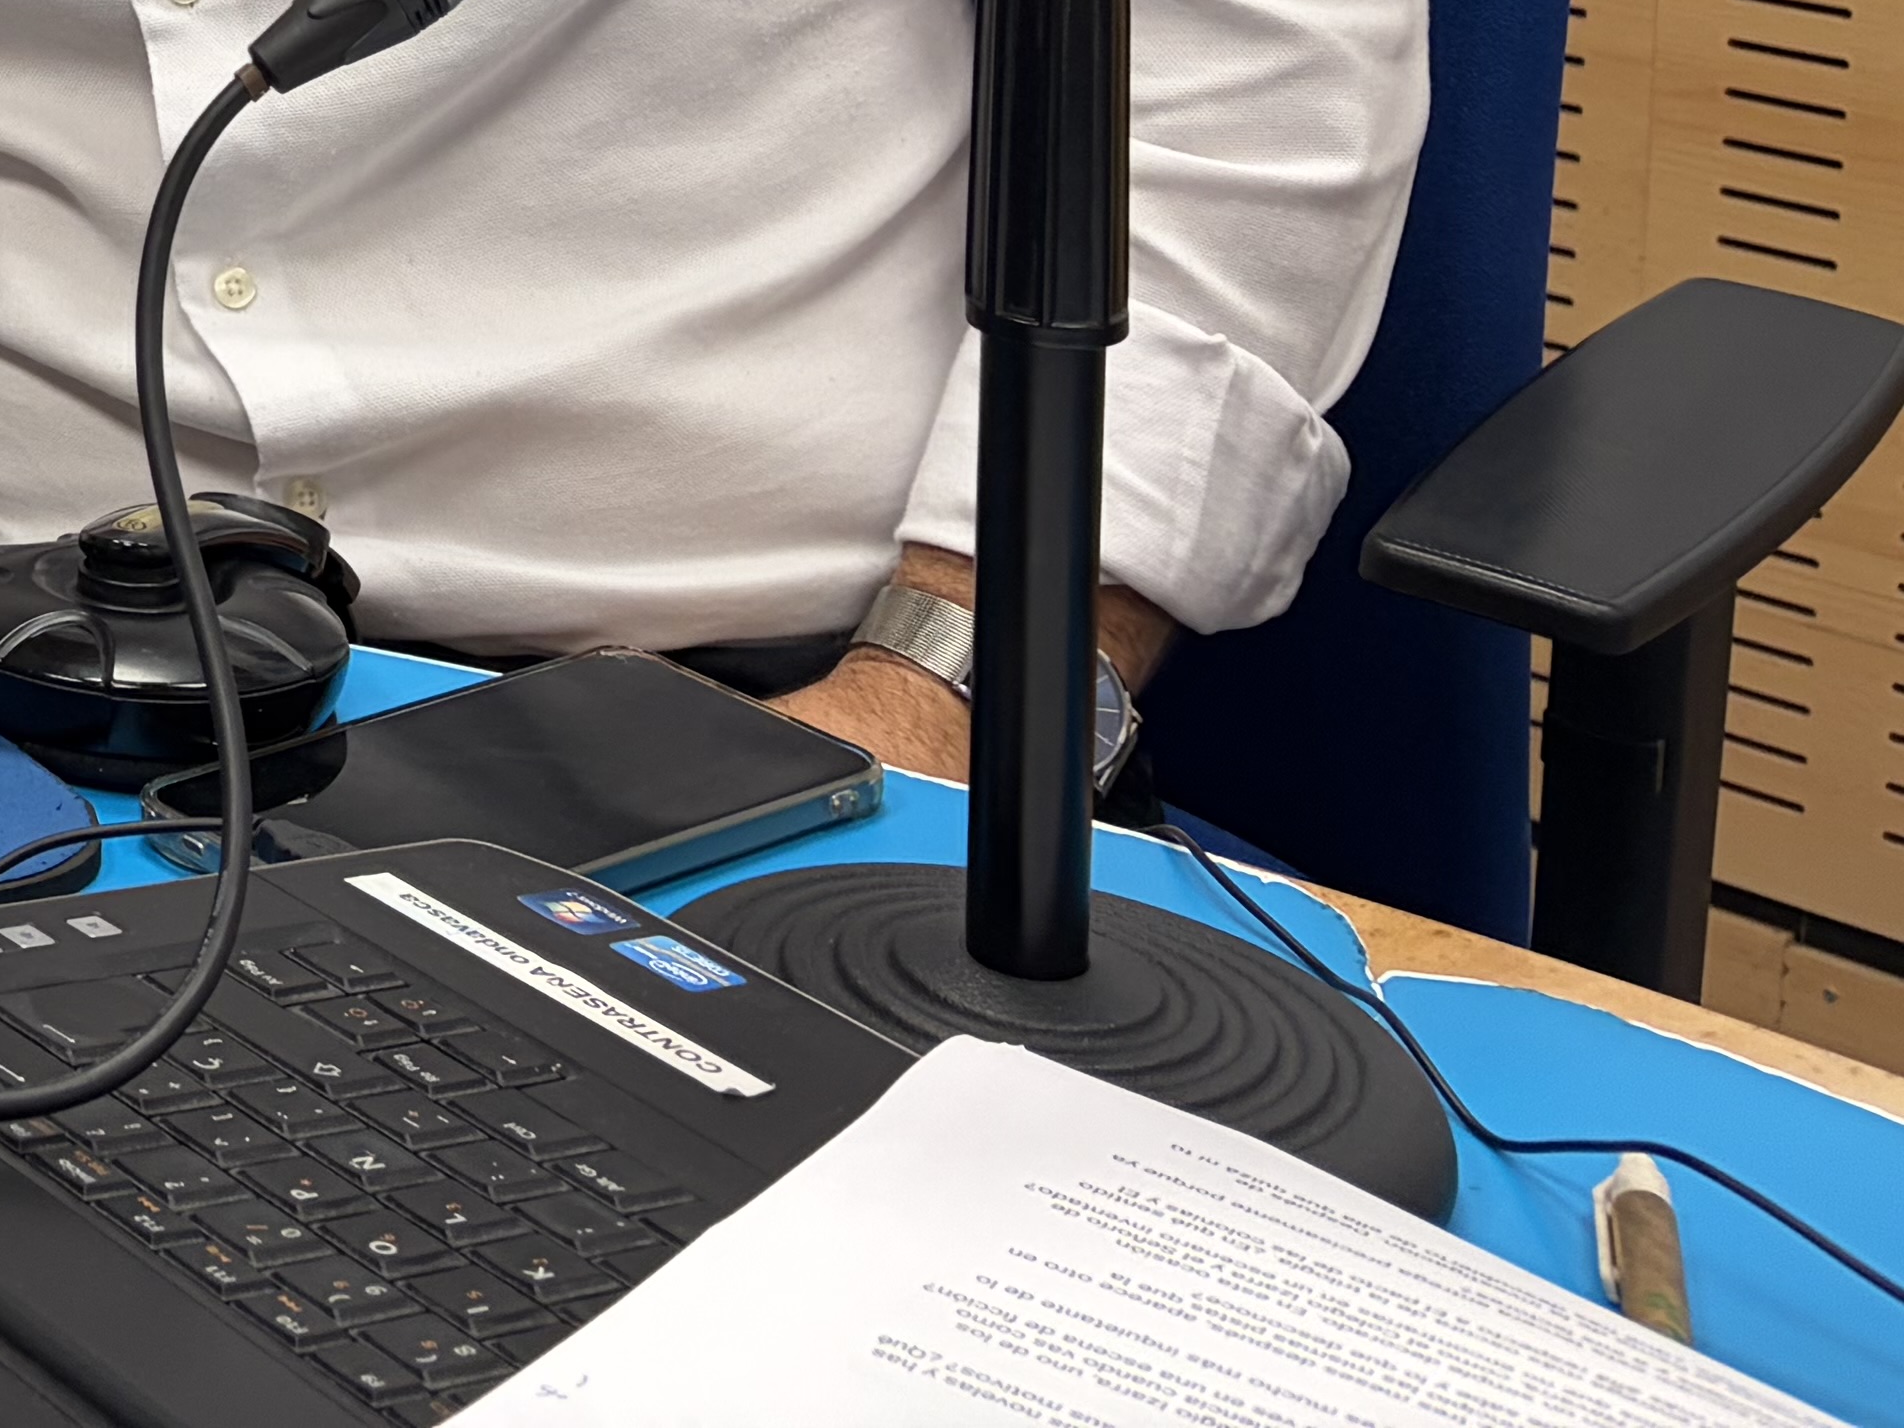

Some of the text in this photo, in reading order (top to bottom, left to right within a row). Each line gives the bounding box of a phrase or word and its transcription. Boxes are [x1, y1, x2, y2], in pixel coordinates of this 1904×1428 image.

[398, 892, 723, 1076] CONTRASEÑA ondavasca
[1050, 1202, 1081, 1218] de
[1008, 1247, 1038, 1263] en
[975, 1274, 999, 1290] lo
[1044, 1261, 1093, 1283] otro
[1110, 1272, 1132, 1287] la
[923, 1283, 1018, 1324] ficción?
[1004, 1285, 1035, 1301] de
[955, 1322, 993, 1344] los
[956, 1308, 1026, 1340] como
[1024, 1320, 1056, 1336] de
[1041, 1300, 1179, 1357] inquietante
[998, 1339, 1030, 1357] de
[1033, 1337, 1075, 1360] vas
[871, 1348, 918, 1373] has
[1036, 1354, 1084, 1377] uno
[945, 1363, 1063, 1412] motivos?
[1083, 1357, 1177, 1397] cuando
[1159, 1370, 1207, 1394] una
[944, 1376, 1042, 1420] novelas
